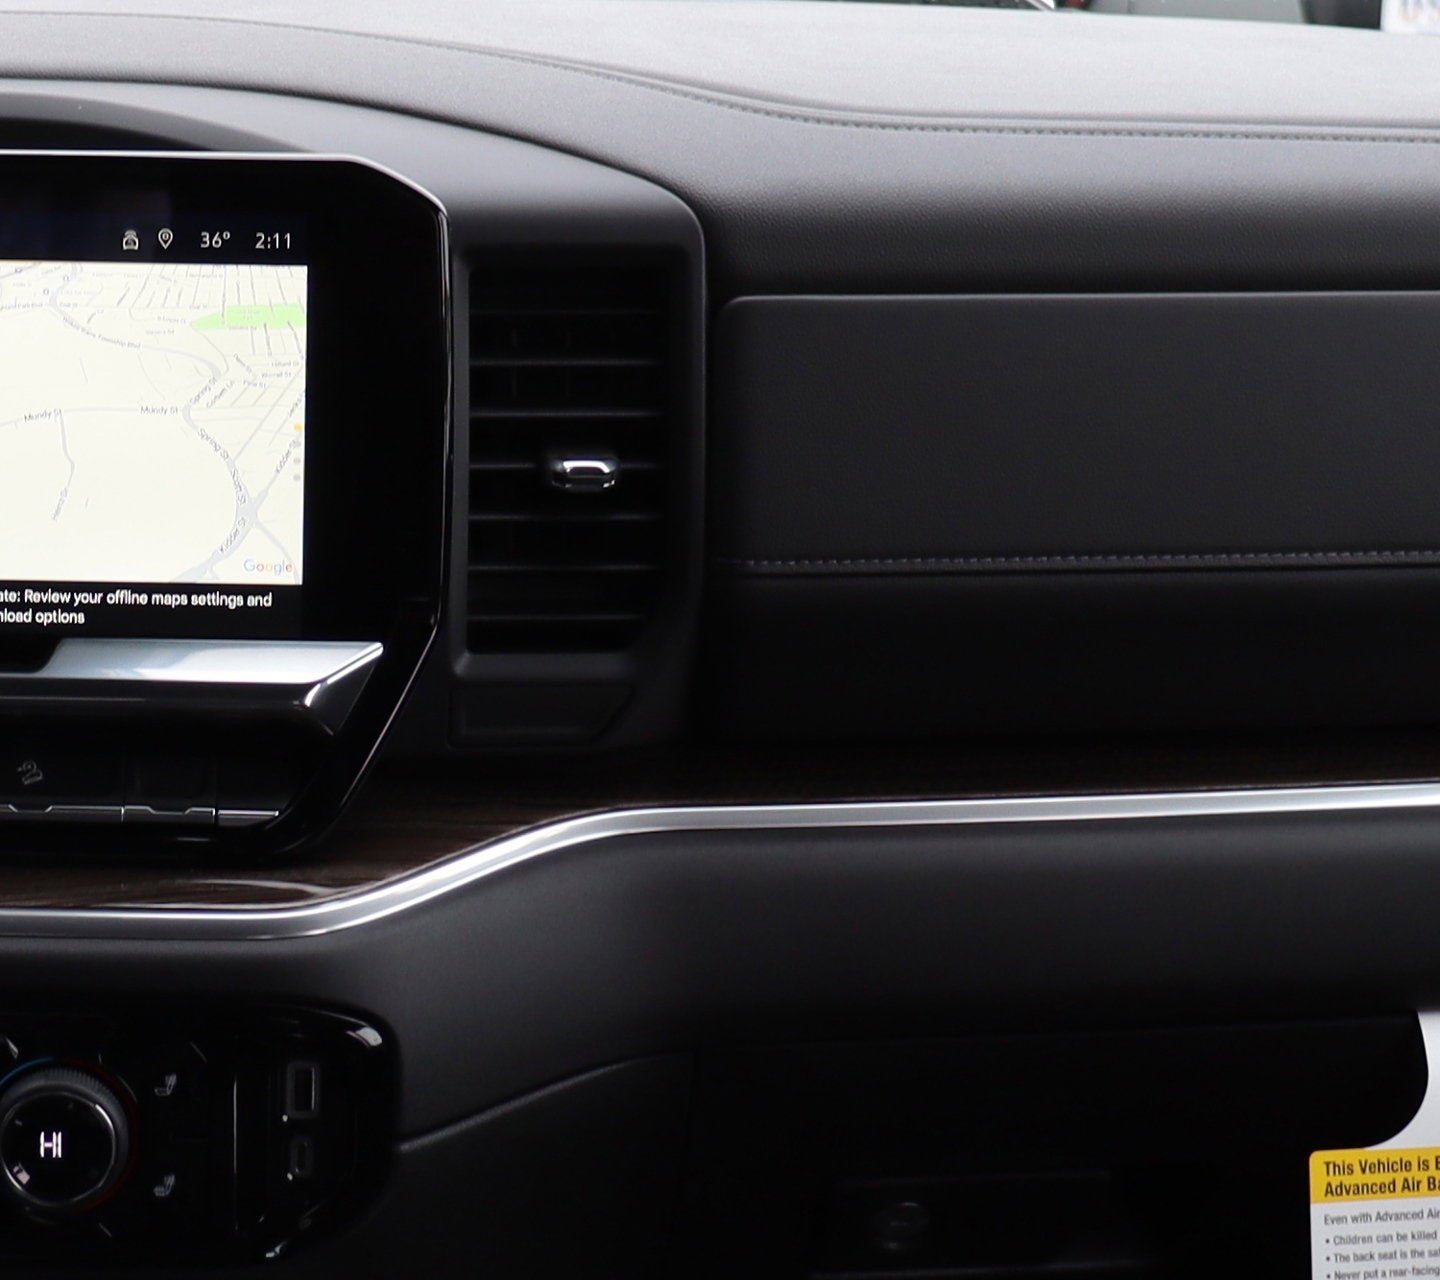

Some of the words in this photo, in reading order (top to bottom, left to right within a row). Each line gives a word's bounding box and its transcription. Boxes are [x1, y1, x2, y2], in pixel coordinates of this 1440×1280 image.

[254, 231, 291, 250] 2:11
[24, 410, 52, 423] Mundy
[140, 406, 169, 416] Mundy
[170, 405, 179, 414] St
[198, 428, 221, 452] Spring
[244, 559, 294, 576] Google
[24, 589, 71, 604] Review
[74, 592, 103, 608] your
[106, 590, 148, 606] offline
[151, 593, 188, 608] maps
[191, 591, 244, 609] settings
[247, 592, 273, 608] and
[35, 610, 86, 627] options
[38, 1131, 63, 1159] HI
[1323, 1160, 1355, 1177] This
[1359, 1157, 1413, 1175] Vehicle
[1417, 1156, 1430, 1171] is
[1324, 1178, 1396, 1197] Advanced
[1401, 1177, 1422, 1193] Air
[1323, 1214, 1348, 1225] Even
[1351, 1212, 1373, 1224] with
[1375, 1209, 1424, 1223] Advanced
[1426, 1208, 1440, 1219] Air
[1333, 1234, 1373, 1246] Children
[1376, 1233, 1393, 1244] can
[1396, 1232, 1408, 1242] be
[1411, 1230, 1437, 1241] killed
[1333, 1252, 1351, 1263] The
[1353, 1251, 1375, 1262] back
[1377, 1250, 1397, 1261] seat
[1399, 1249, 1408, 1260] is
[1410, 1248, 1425, 1258] the
[1334, 1270, 1360, 1280] Never
[1363, 1269, 1378, 1280] put
[1380, 1270, 1387, 1278] a
[1389, 1266, 1440, 1278] rear-facing
